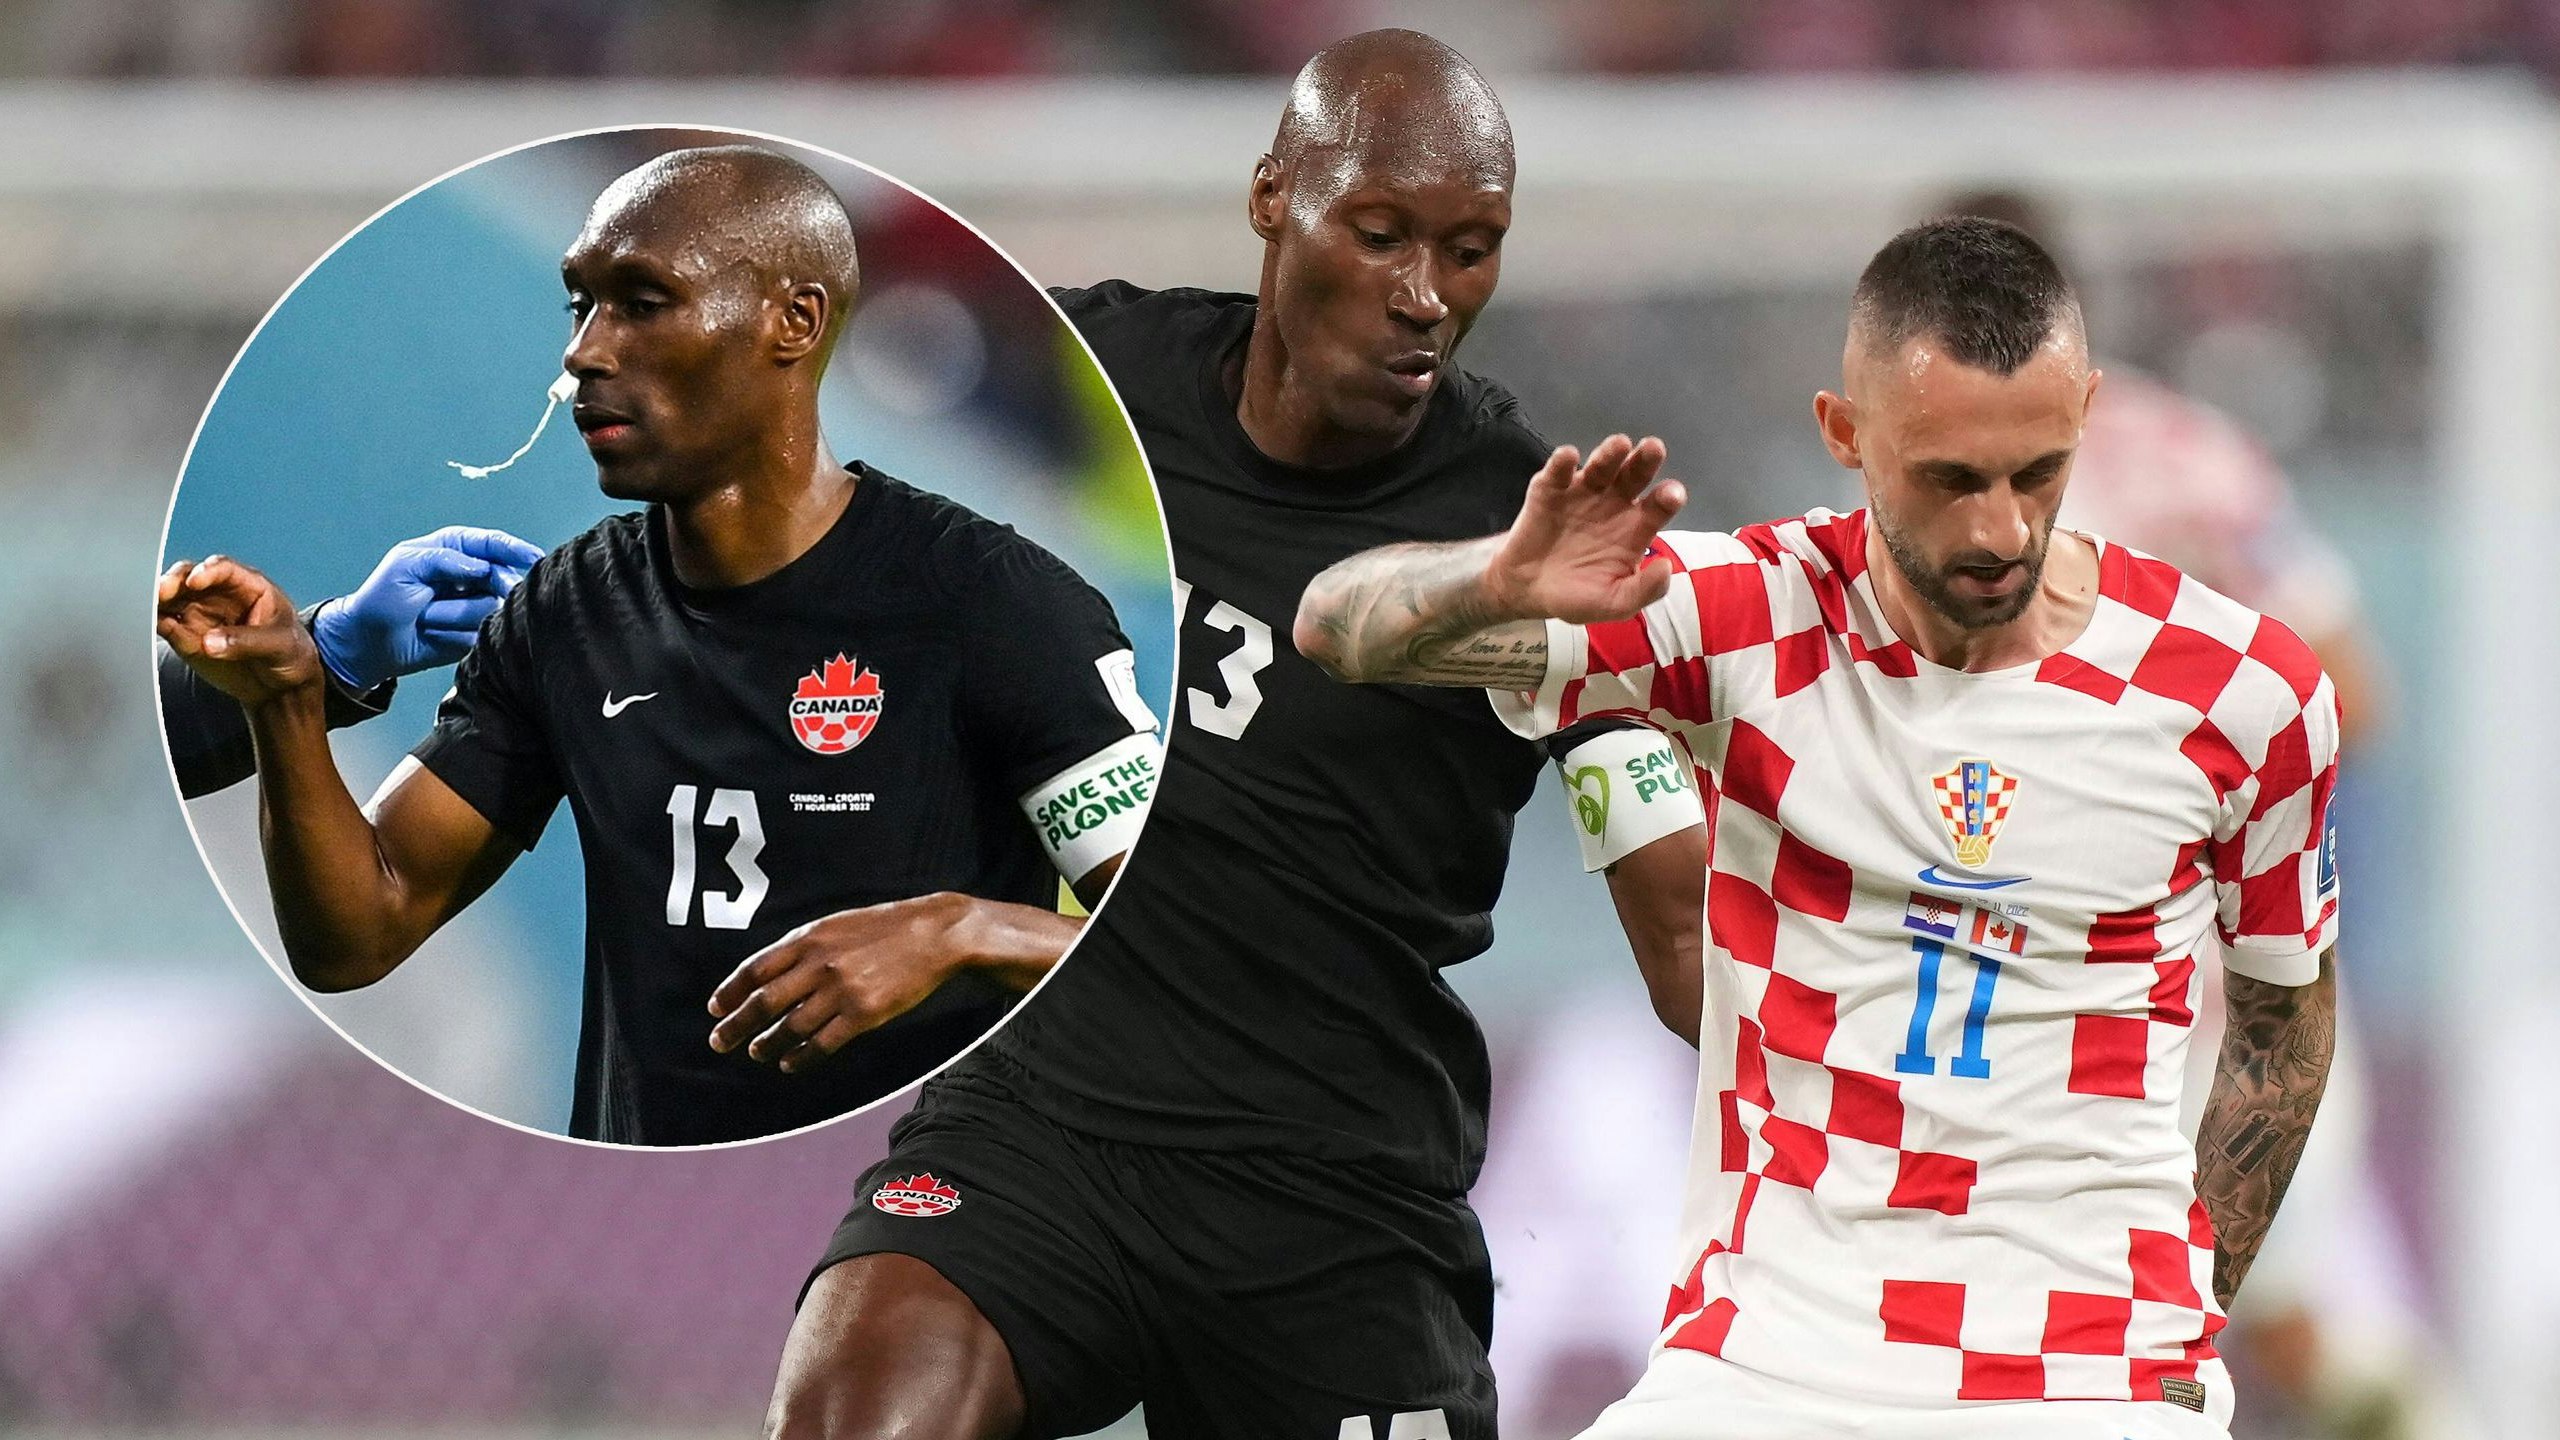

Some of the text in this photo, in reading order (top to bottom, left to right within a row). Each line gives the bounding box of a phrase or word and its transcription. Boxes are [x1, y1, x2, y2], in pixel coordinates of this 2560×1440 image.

[1176, 577, 1274, 741] 3
[792, 698, 878, 715] CANADA
[1625, 747, 1674, 779] SAV
[789, 793, 825, 803] CANADA
[835, 793, 875, 803] CROATIA
[794, 803, 870, 811] 27 NOVEMBER 2022
[1037, 755, 1153, 827] SAVE THE
[1968, 768, 1983, 826] HNS
[666, 784, 770, 930] 13
[1895, 936, 2001, 1078] 11
[877, 1191, 954, 1208] CANADA
